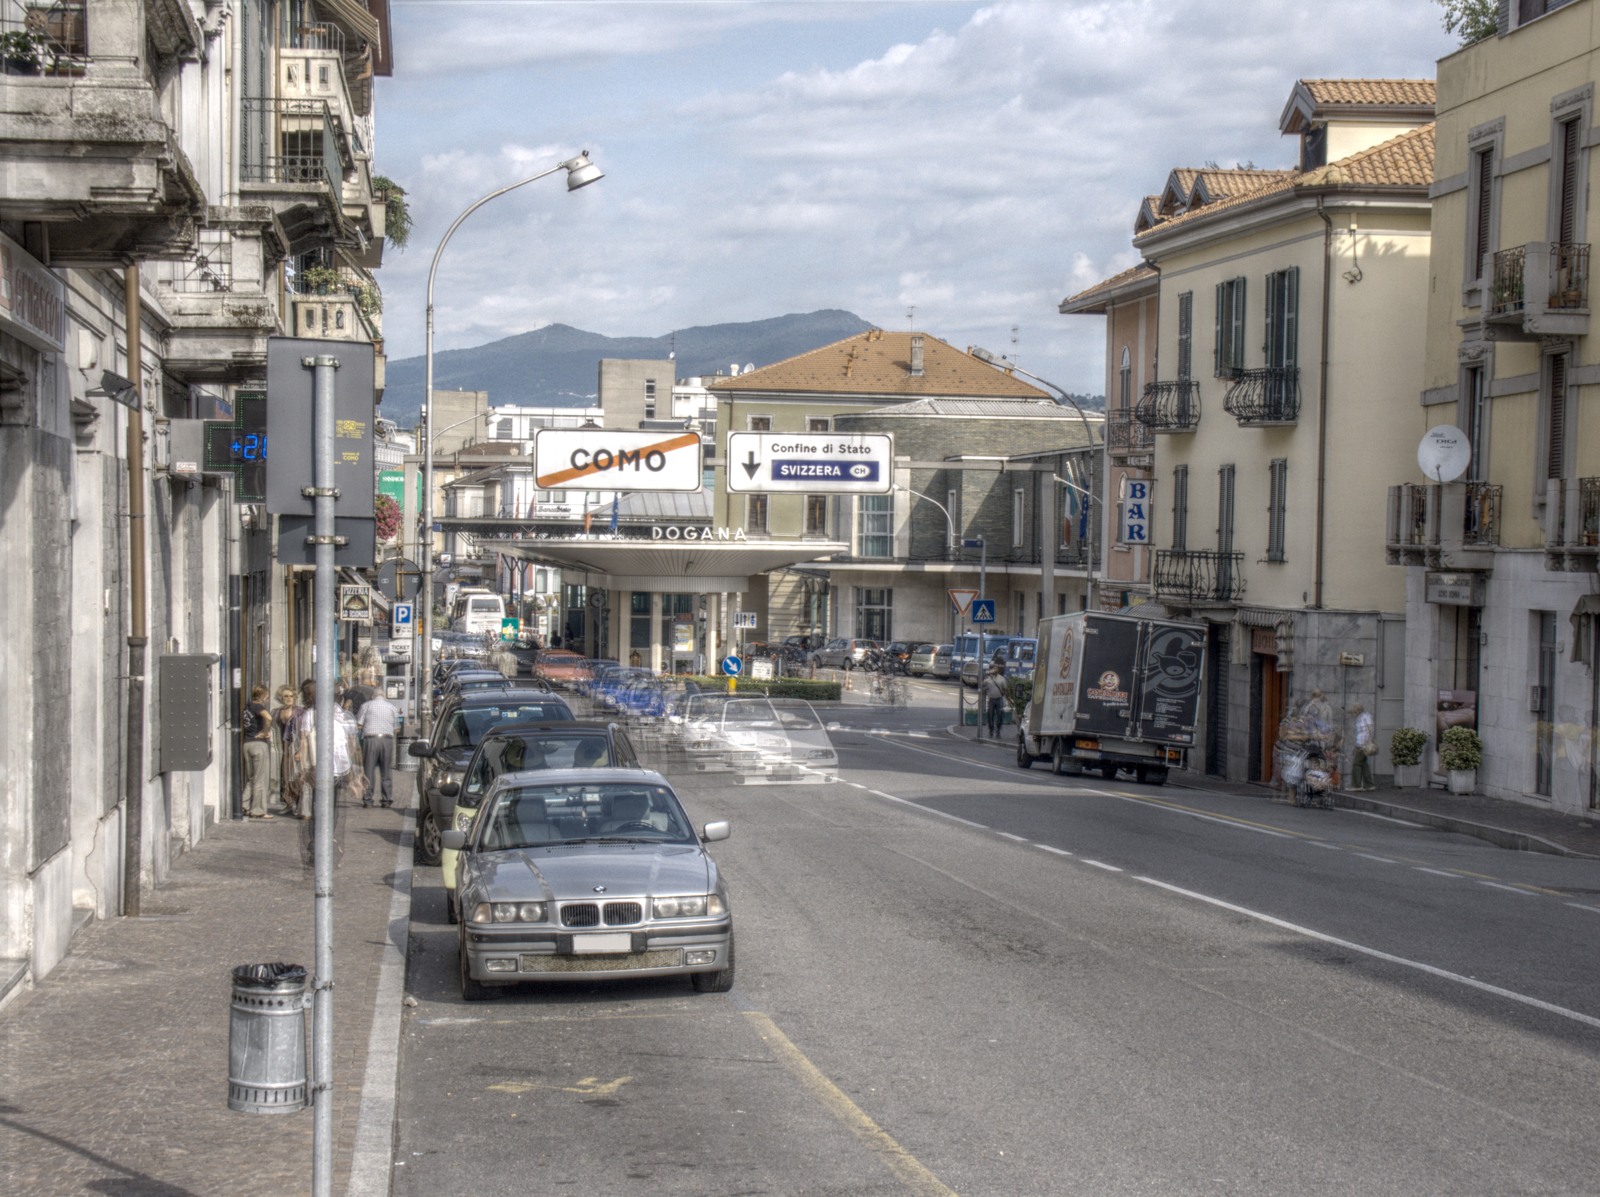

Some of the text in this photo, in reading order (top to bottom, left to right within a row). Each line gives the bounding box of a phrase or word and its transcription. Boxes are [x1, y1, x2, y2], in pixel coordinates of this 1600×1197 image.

[771, 443, 872, 454] Confine di Stato
[570, 448, 666, 472] COMO
[781, 465, 866, 476] SVIZZERA CH
[1128, 482, 1146, 541] BAR
[652, 526, 748, 541] DOGANA
[343, 587, 368, 595] PIZZERIA
[398, 607, 408, 622] P
